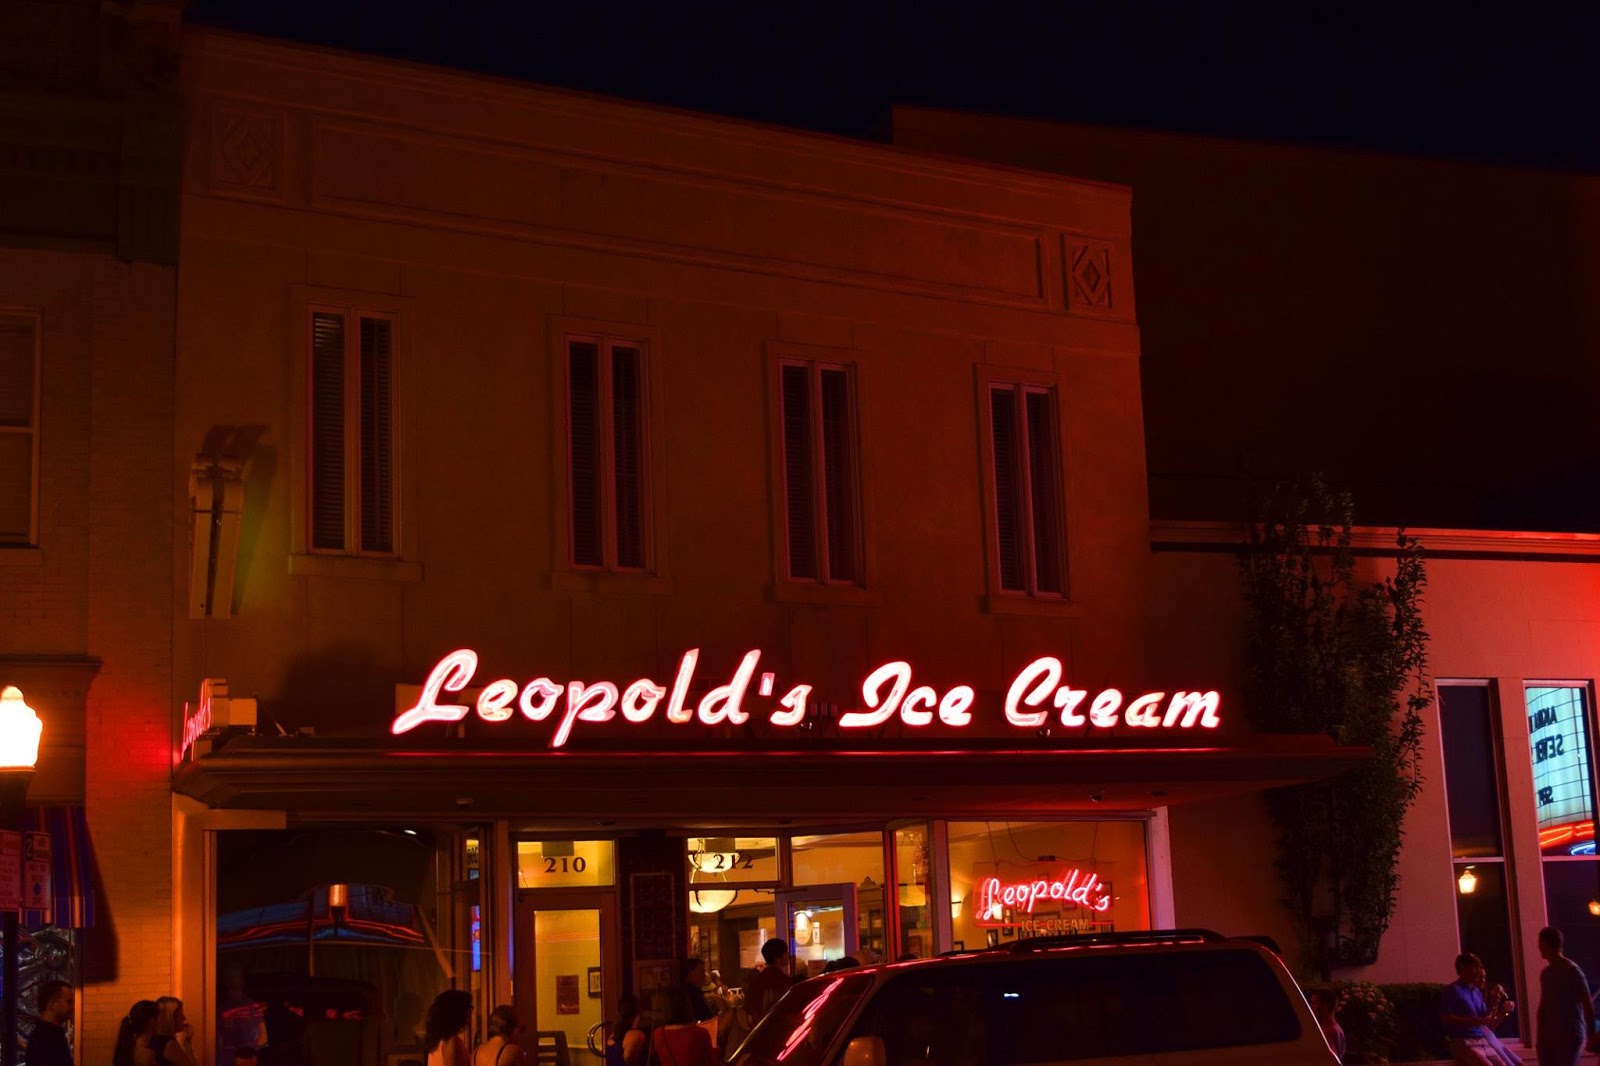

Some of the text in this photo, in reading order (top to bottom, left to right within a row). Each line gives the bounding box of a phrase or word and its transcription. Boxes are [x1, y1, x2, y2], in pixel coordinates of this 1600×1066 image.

[392, 648, 1221, 749] Leopold's Ice Cream
[544, 856, 586, 873] 210
[713, 854, 754, 870] 212
[980, 868, 1111, 921] Leopold's
[1021, 918, 1089, 933] ICE CREAM
